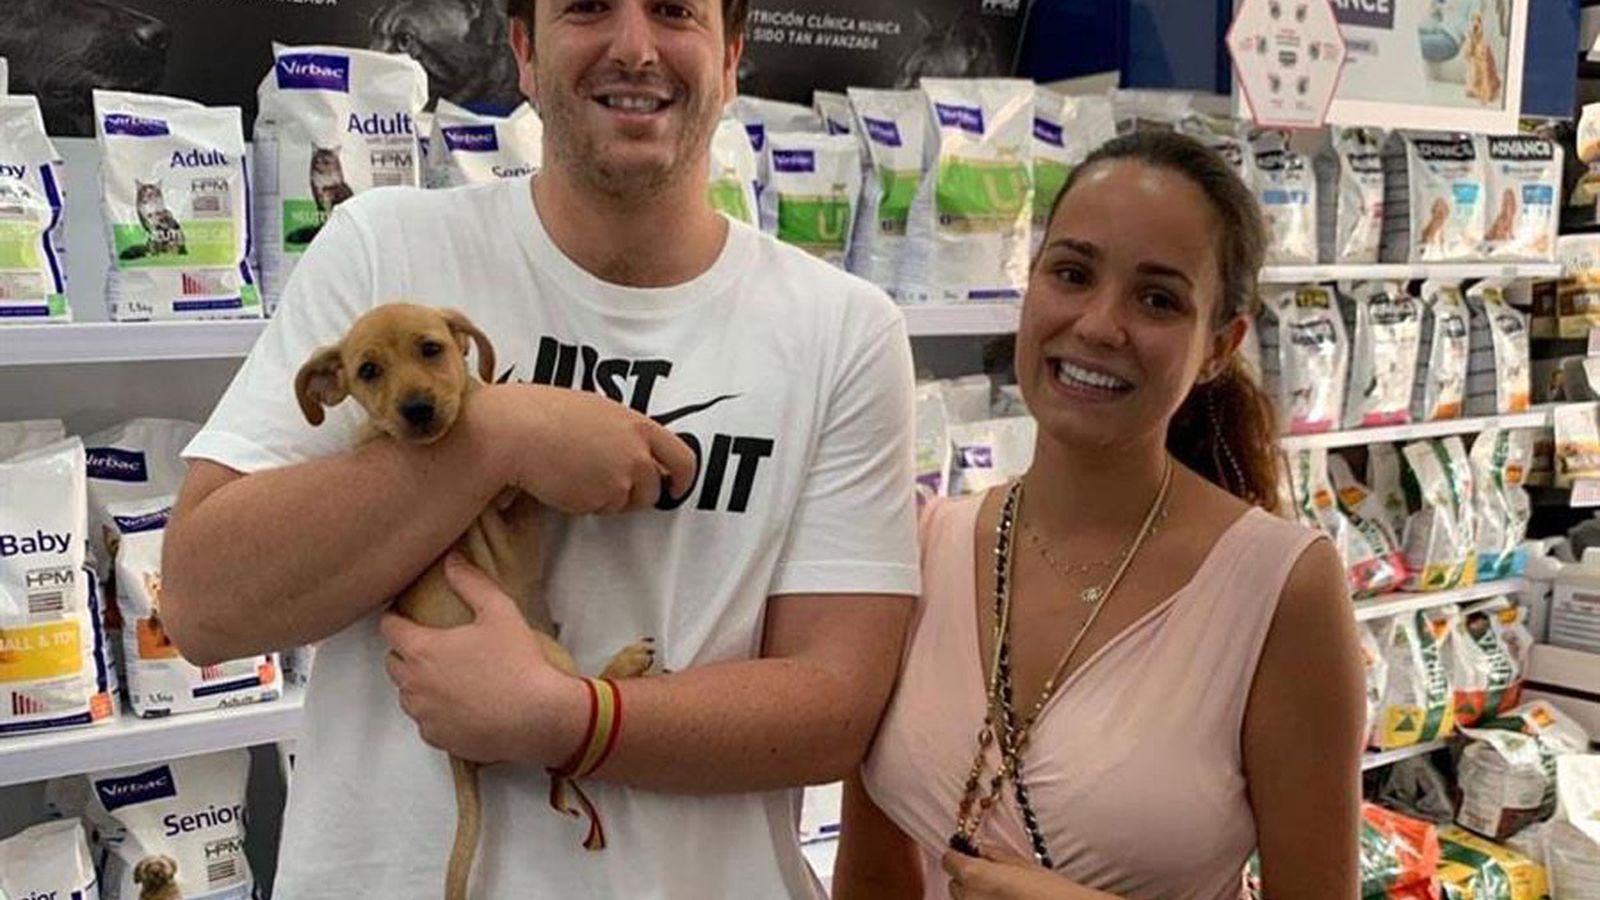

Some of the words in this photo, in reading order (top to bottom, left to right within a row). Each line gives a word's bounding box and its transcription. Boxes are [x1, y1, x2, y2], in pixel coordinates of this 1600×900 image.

[748, 10, 804, 27] TRICIÓN
[807, 14, 855, 31] CLÍNICA
[753, 27, 784, 42] SIDO
[788, 30, 812, 44] TAN
[815, 32, 879, 49] AVANZADA
[280, 60, 344, 79] Virbac
[347, 112, 413, 135] Adult
[1491, 141, 1550, 157] ADVANCE
[532, 335, 673, 415] JUST
[697, 433, 774, 513] IT
[0, 529, 72, 557] Baby
[26, 570, 75, 588] HPM
[101, 776, 167, 796] Virbac
[163, 804, 242, 837] Senior
